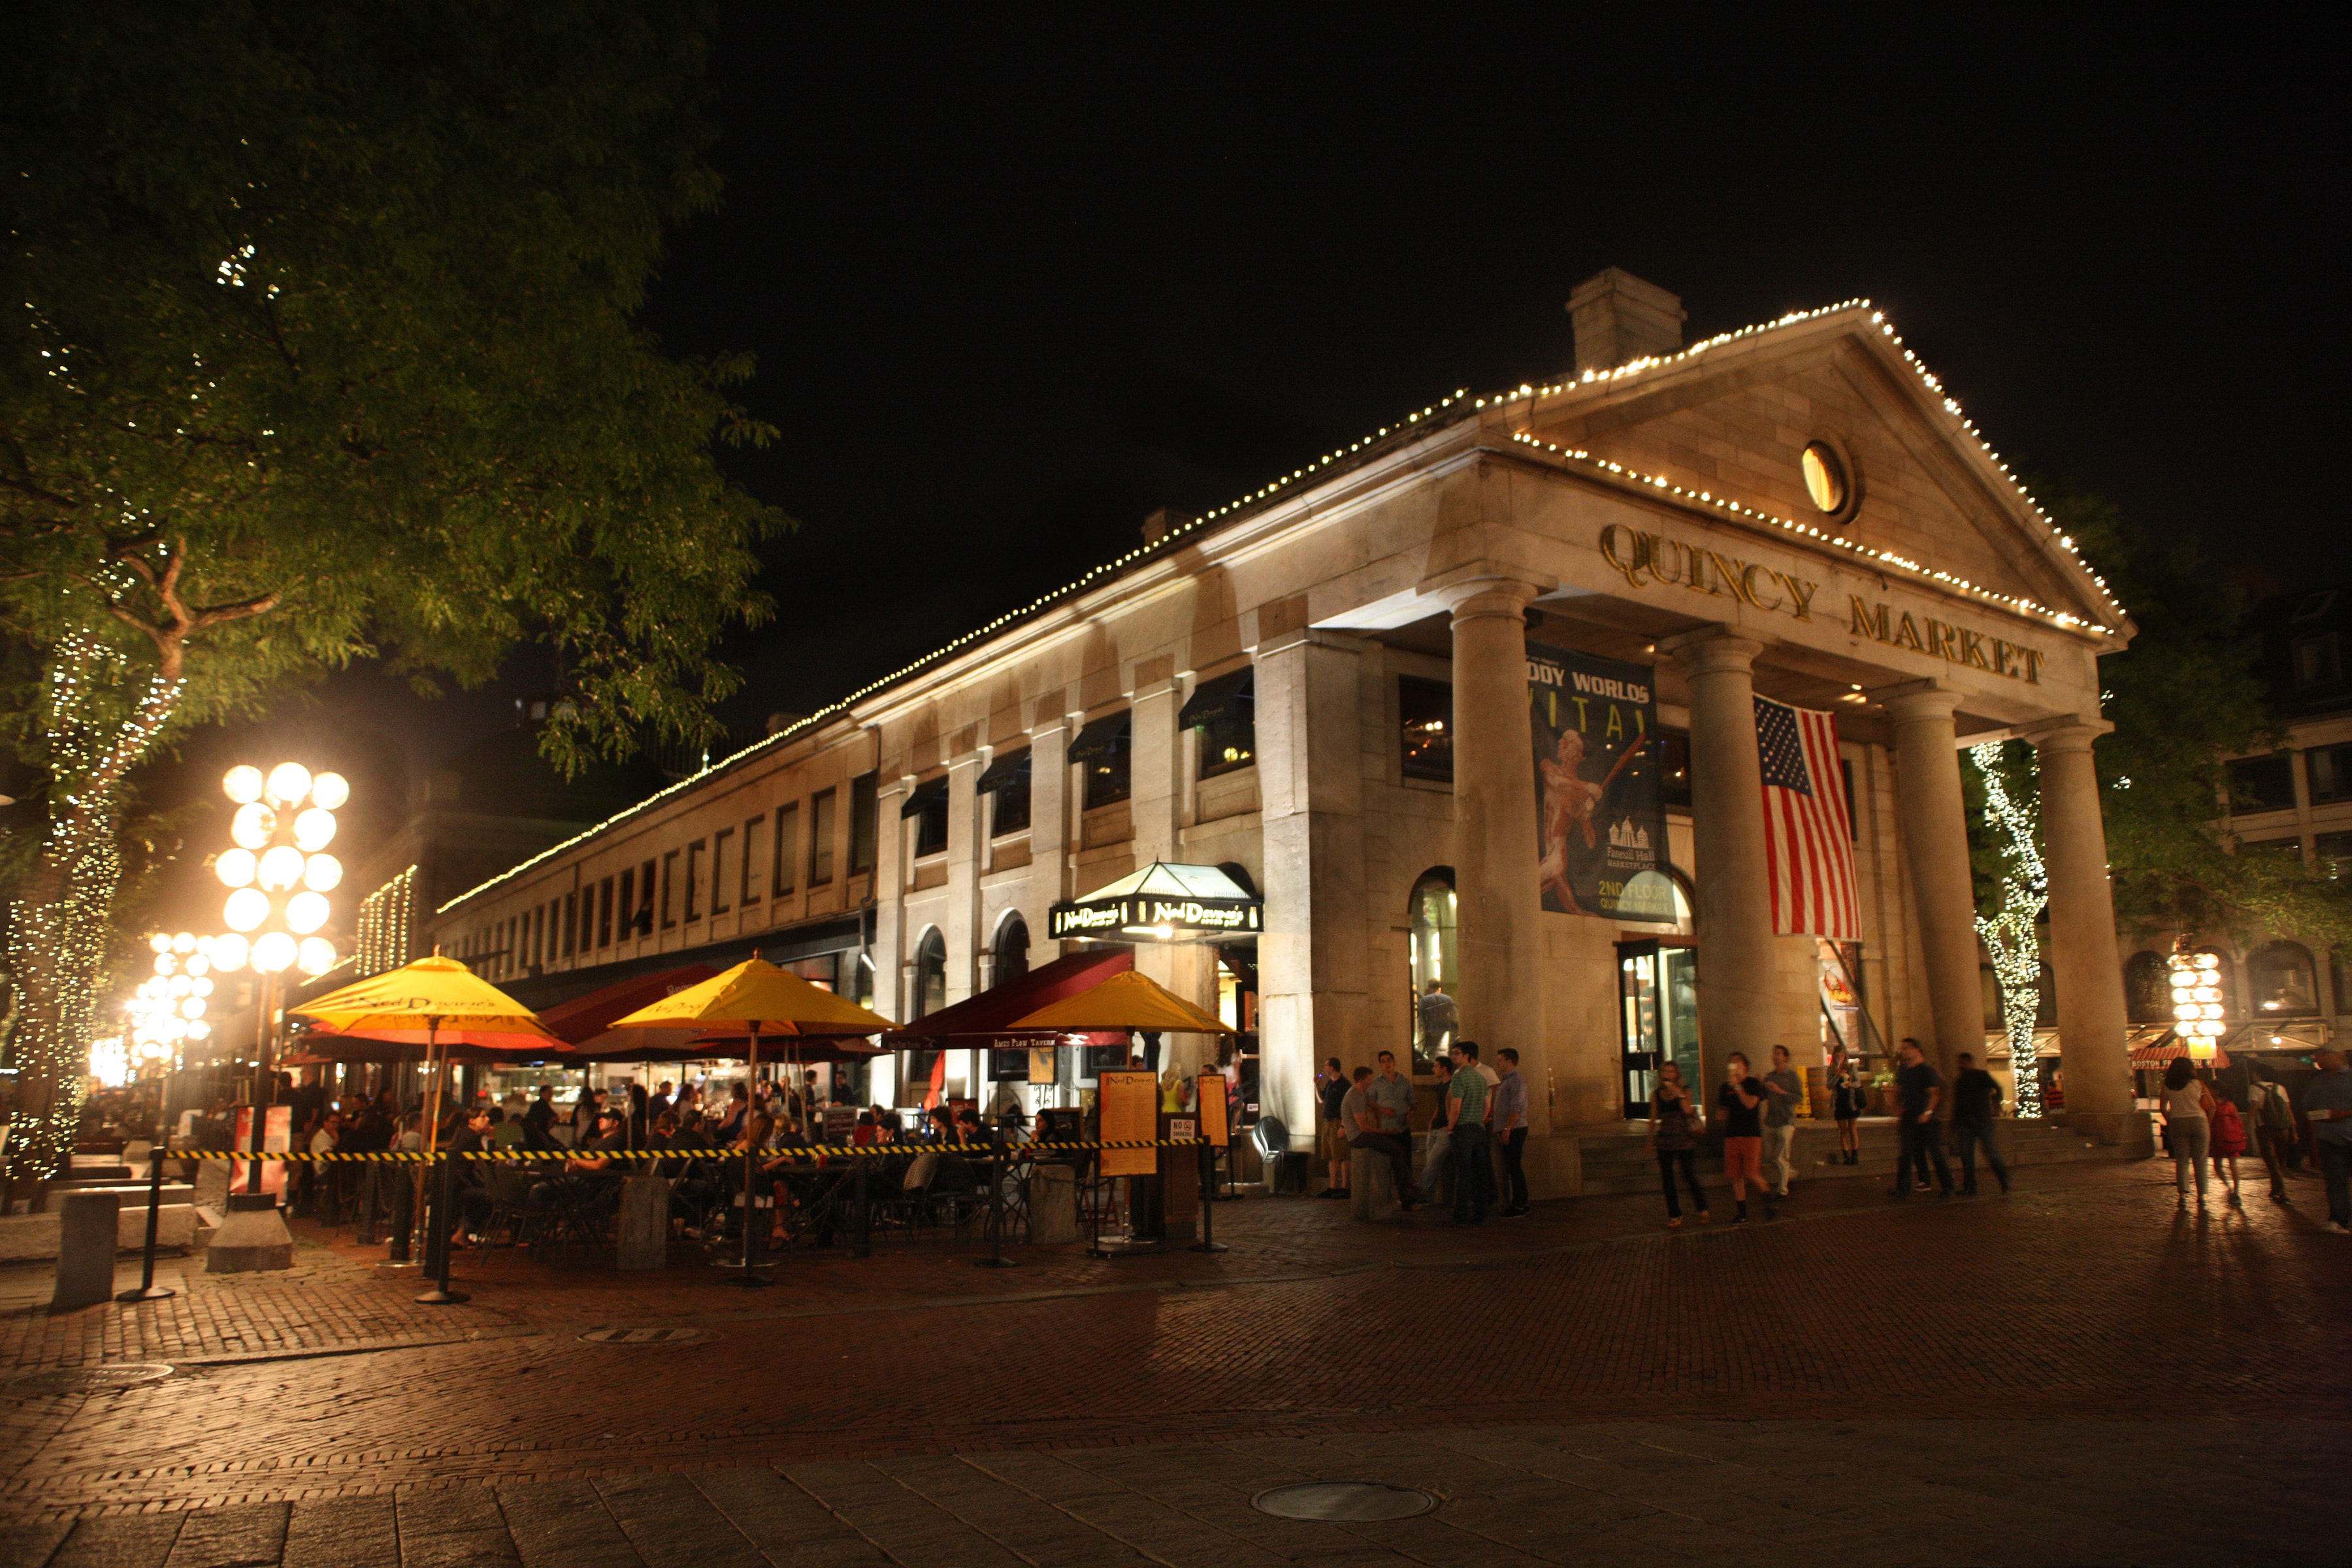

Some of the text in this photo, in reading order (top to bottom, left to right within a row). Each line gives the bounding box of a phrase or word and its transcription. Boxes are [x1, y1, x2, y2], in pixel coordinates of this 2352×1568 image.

[1601, 524, 2046, 685] QUINCY MARKET
[1526, 661, 1650, 704] ODY WORLDS
[1607, 846, 1656, 862] Faneuil Hall
[1607, 858, 1657, 870] MARKETPLACE
[1598, 879, 1667, 900] 2ND FLOOR
[1152, 902, 1244, 923] Ned Devine's
[1600, 898, 1669, 913] QUINCY MARKET
[1063, 903, 1119, 931] Ned Devine's
[359, 996, 404, 1008] Ned
[1110, 1076, 1125, 1085] Ned
[1173, 1121, 1183, 1130] NO
